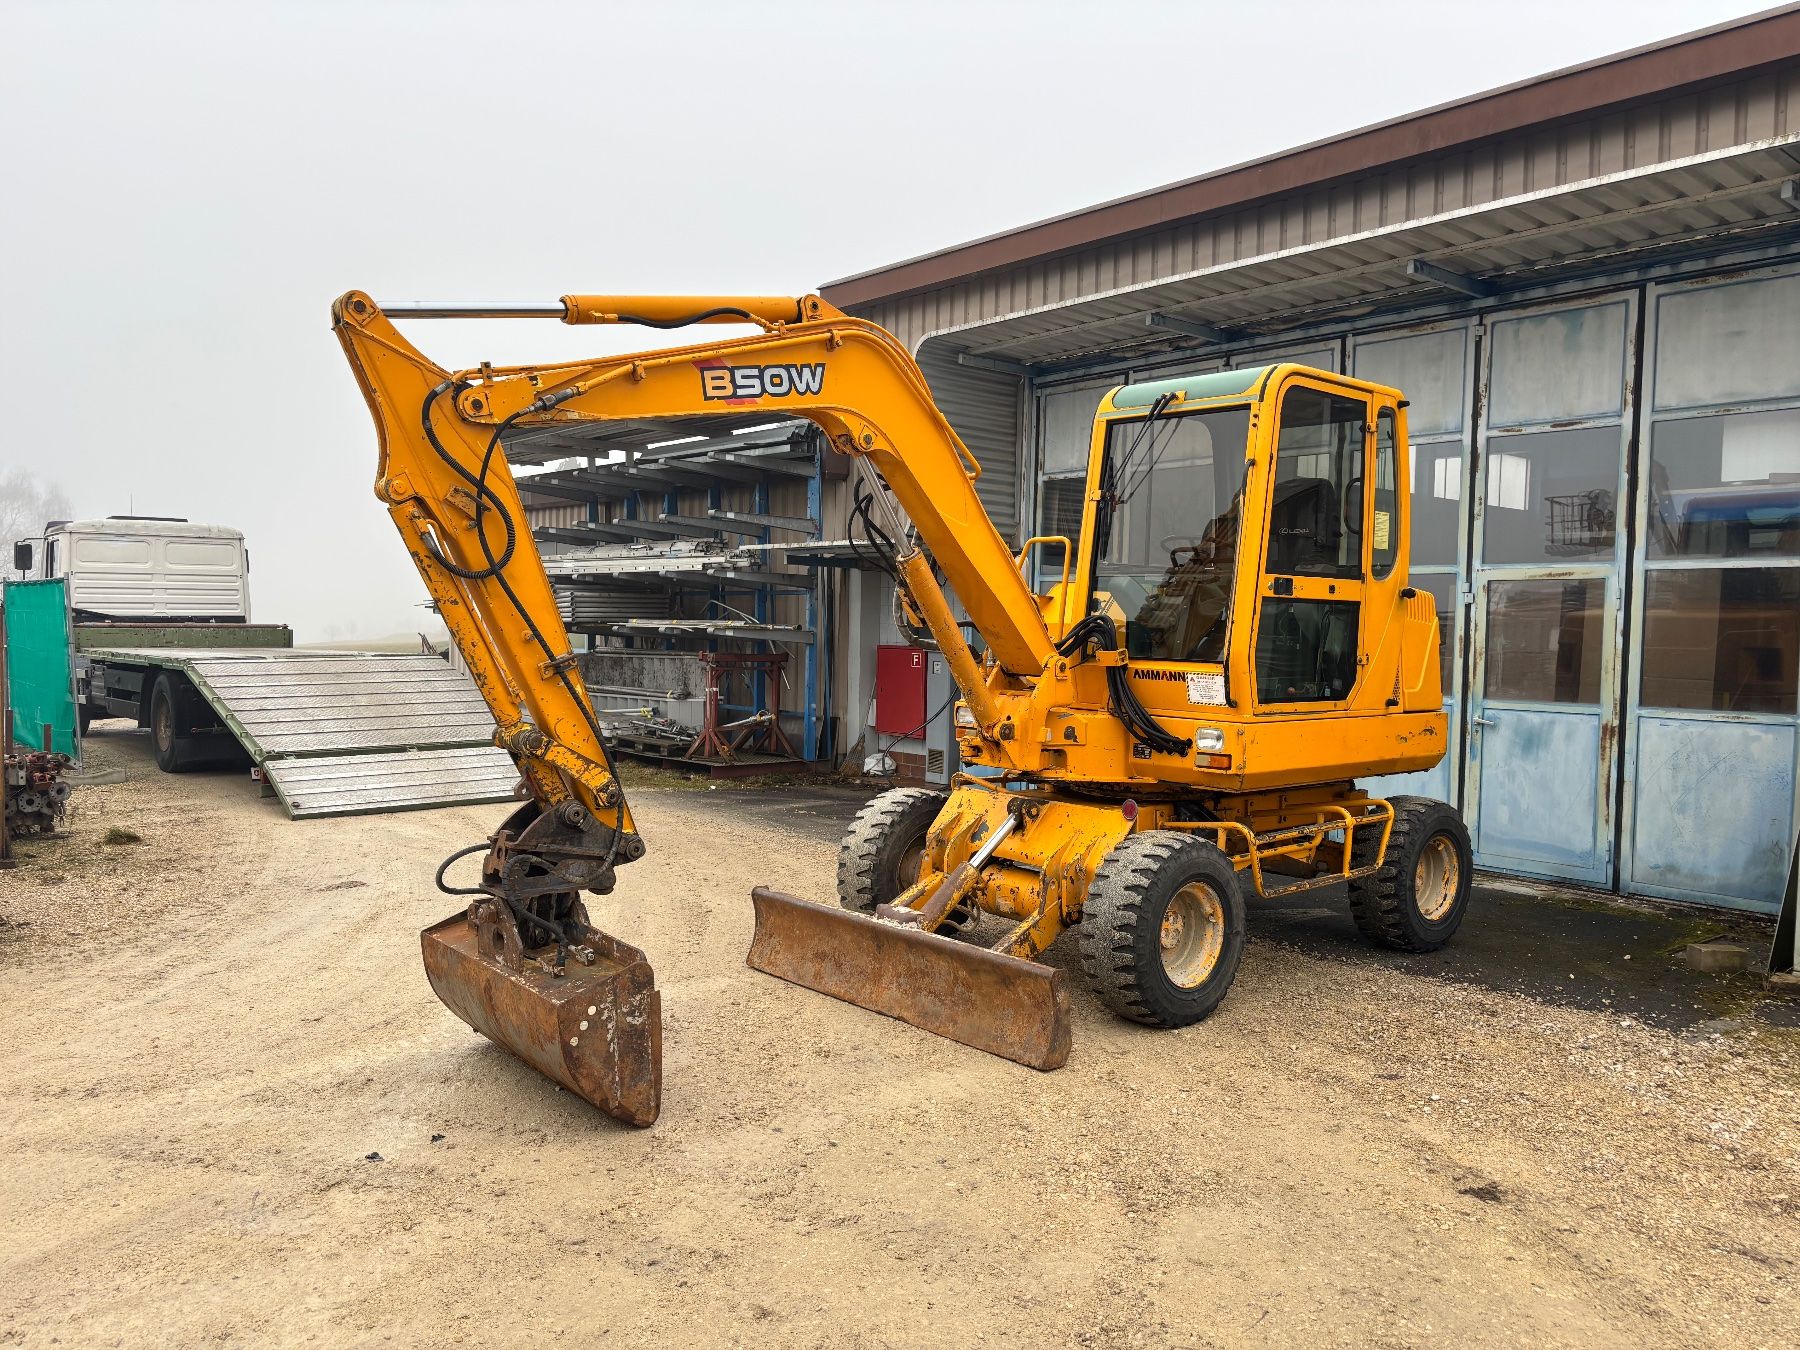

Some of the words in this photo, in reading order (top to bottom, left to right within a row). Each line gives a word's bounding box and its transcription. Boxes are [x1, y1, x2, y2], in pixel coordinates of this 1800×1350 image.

[701, 365, 825, 400] B50W
[913, 655, 919, 666] F
[1133, 669, 1187, 682] AMMANN
